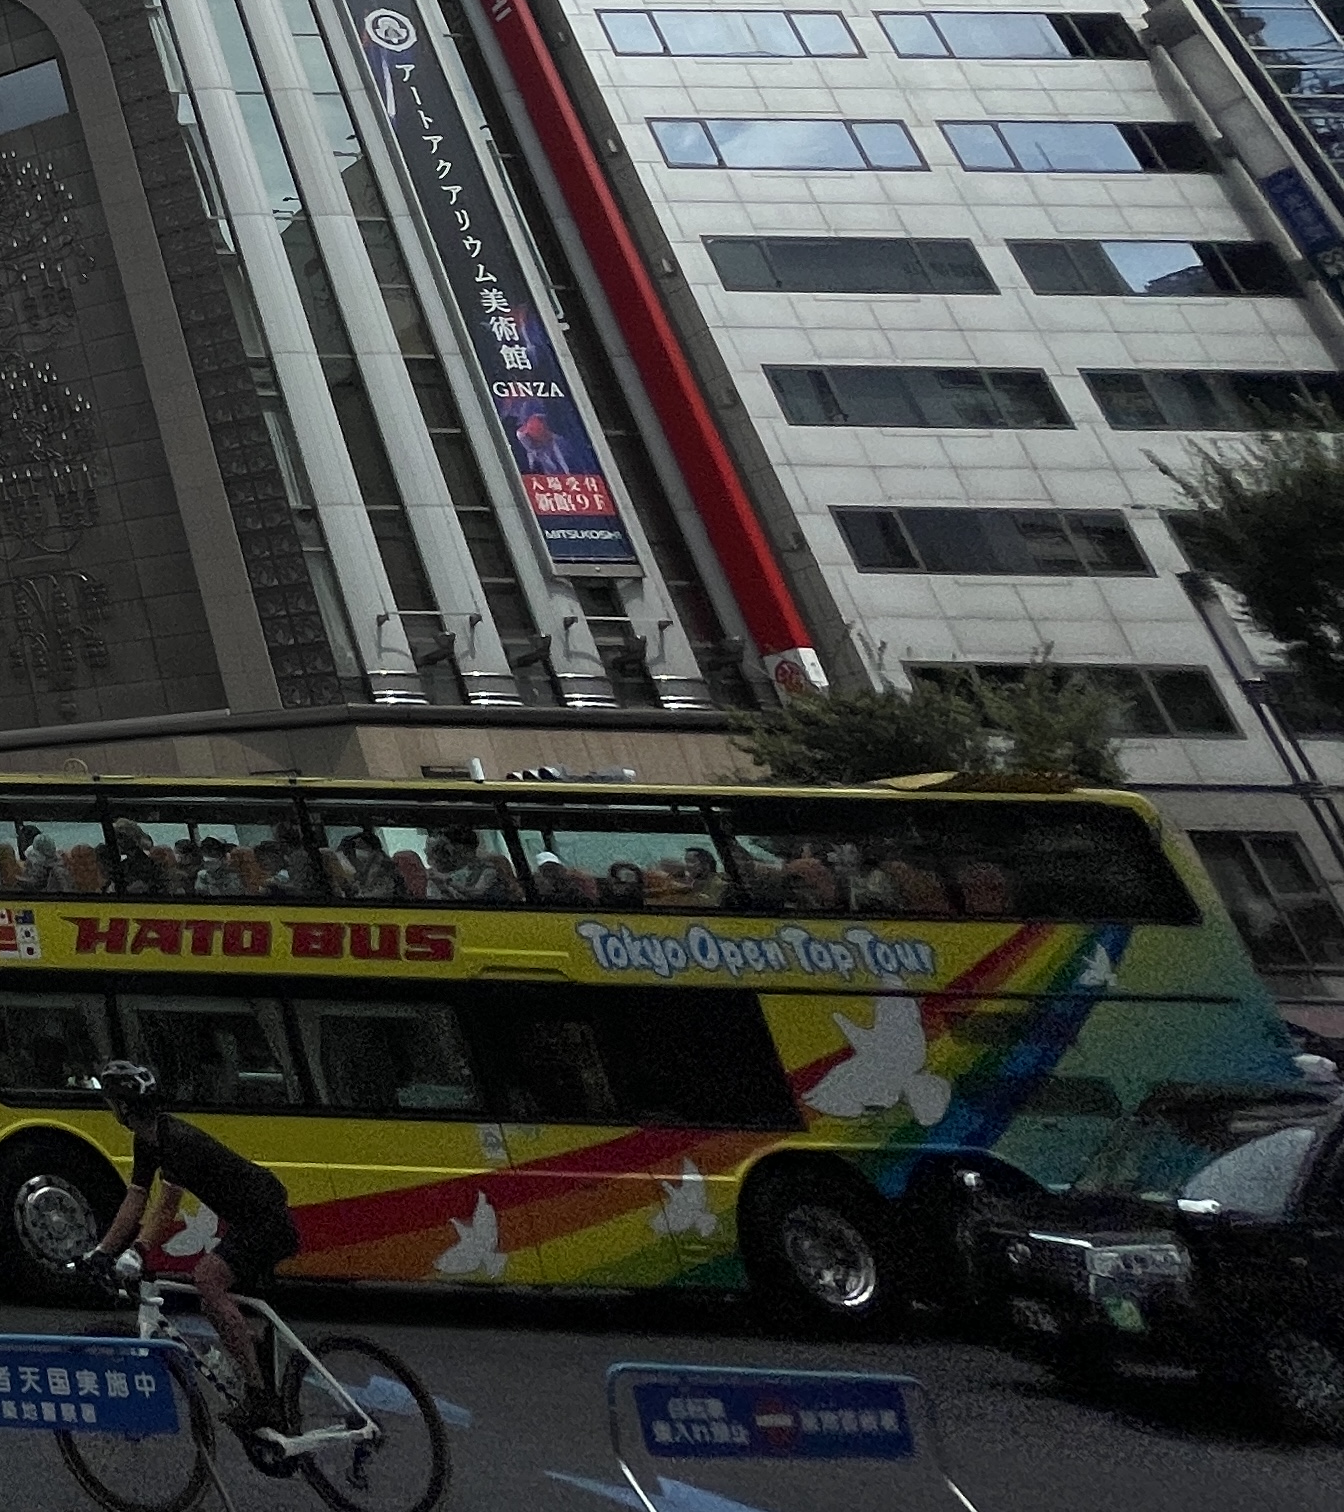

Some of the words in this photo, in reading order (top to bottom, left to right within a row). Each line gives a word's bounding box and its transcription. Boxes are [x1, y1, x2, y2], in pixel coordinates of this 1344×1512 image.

[395, 63, 533, 371] アートアクアリウム美術館
[492, 381, 565, 398] GINZA
[531, 476, 599, 492] 入場受付
[545, 530, 622, 541] MITSUKOSHI
[61, 916, 272, 958] HATO
[281, 921, 457, 962] BUS
[576, 920, 686, 977] Tokyo
[686, 924, 784, 976] Open
[780, 926, 856, 980] Top
[844, 928, 936, 977] Tour
